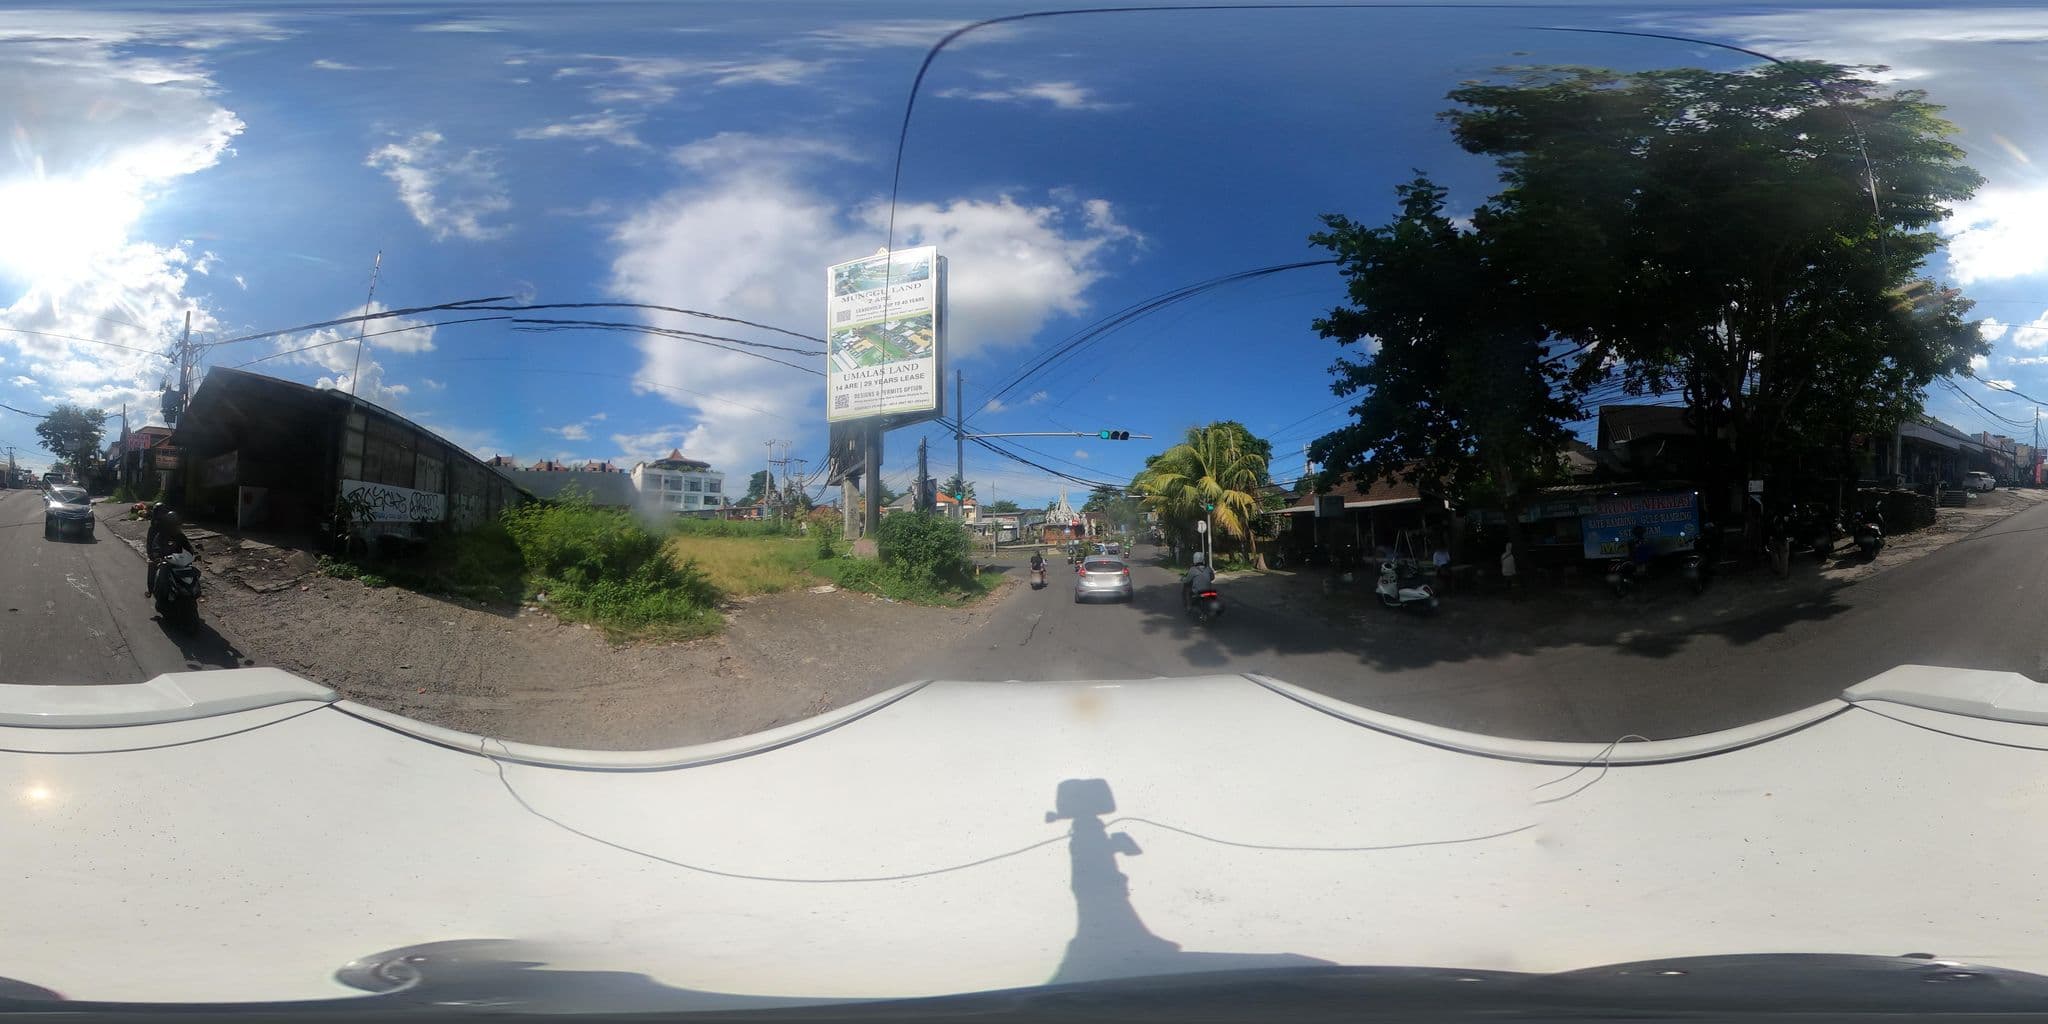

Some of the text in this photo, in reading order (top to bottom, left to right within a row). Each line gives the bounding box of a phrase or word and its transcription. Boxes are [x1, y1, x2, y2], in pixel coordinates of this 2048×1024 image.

[892, 283, 922, 293] LAND
[843, 363, 919, 381] UMALAS LAND
[844, 382, 858, 390] ARE
[874, 376, 899, 385] YEARS
[900, 373, 925, 382] LEASE
